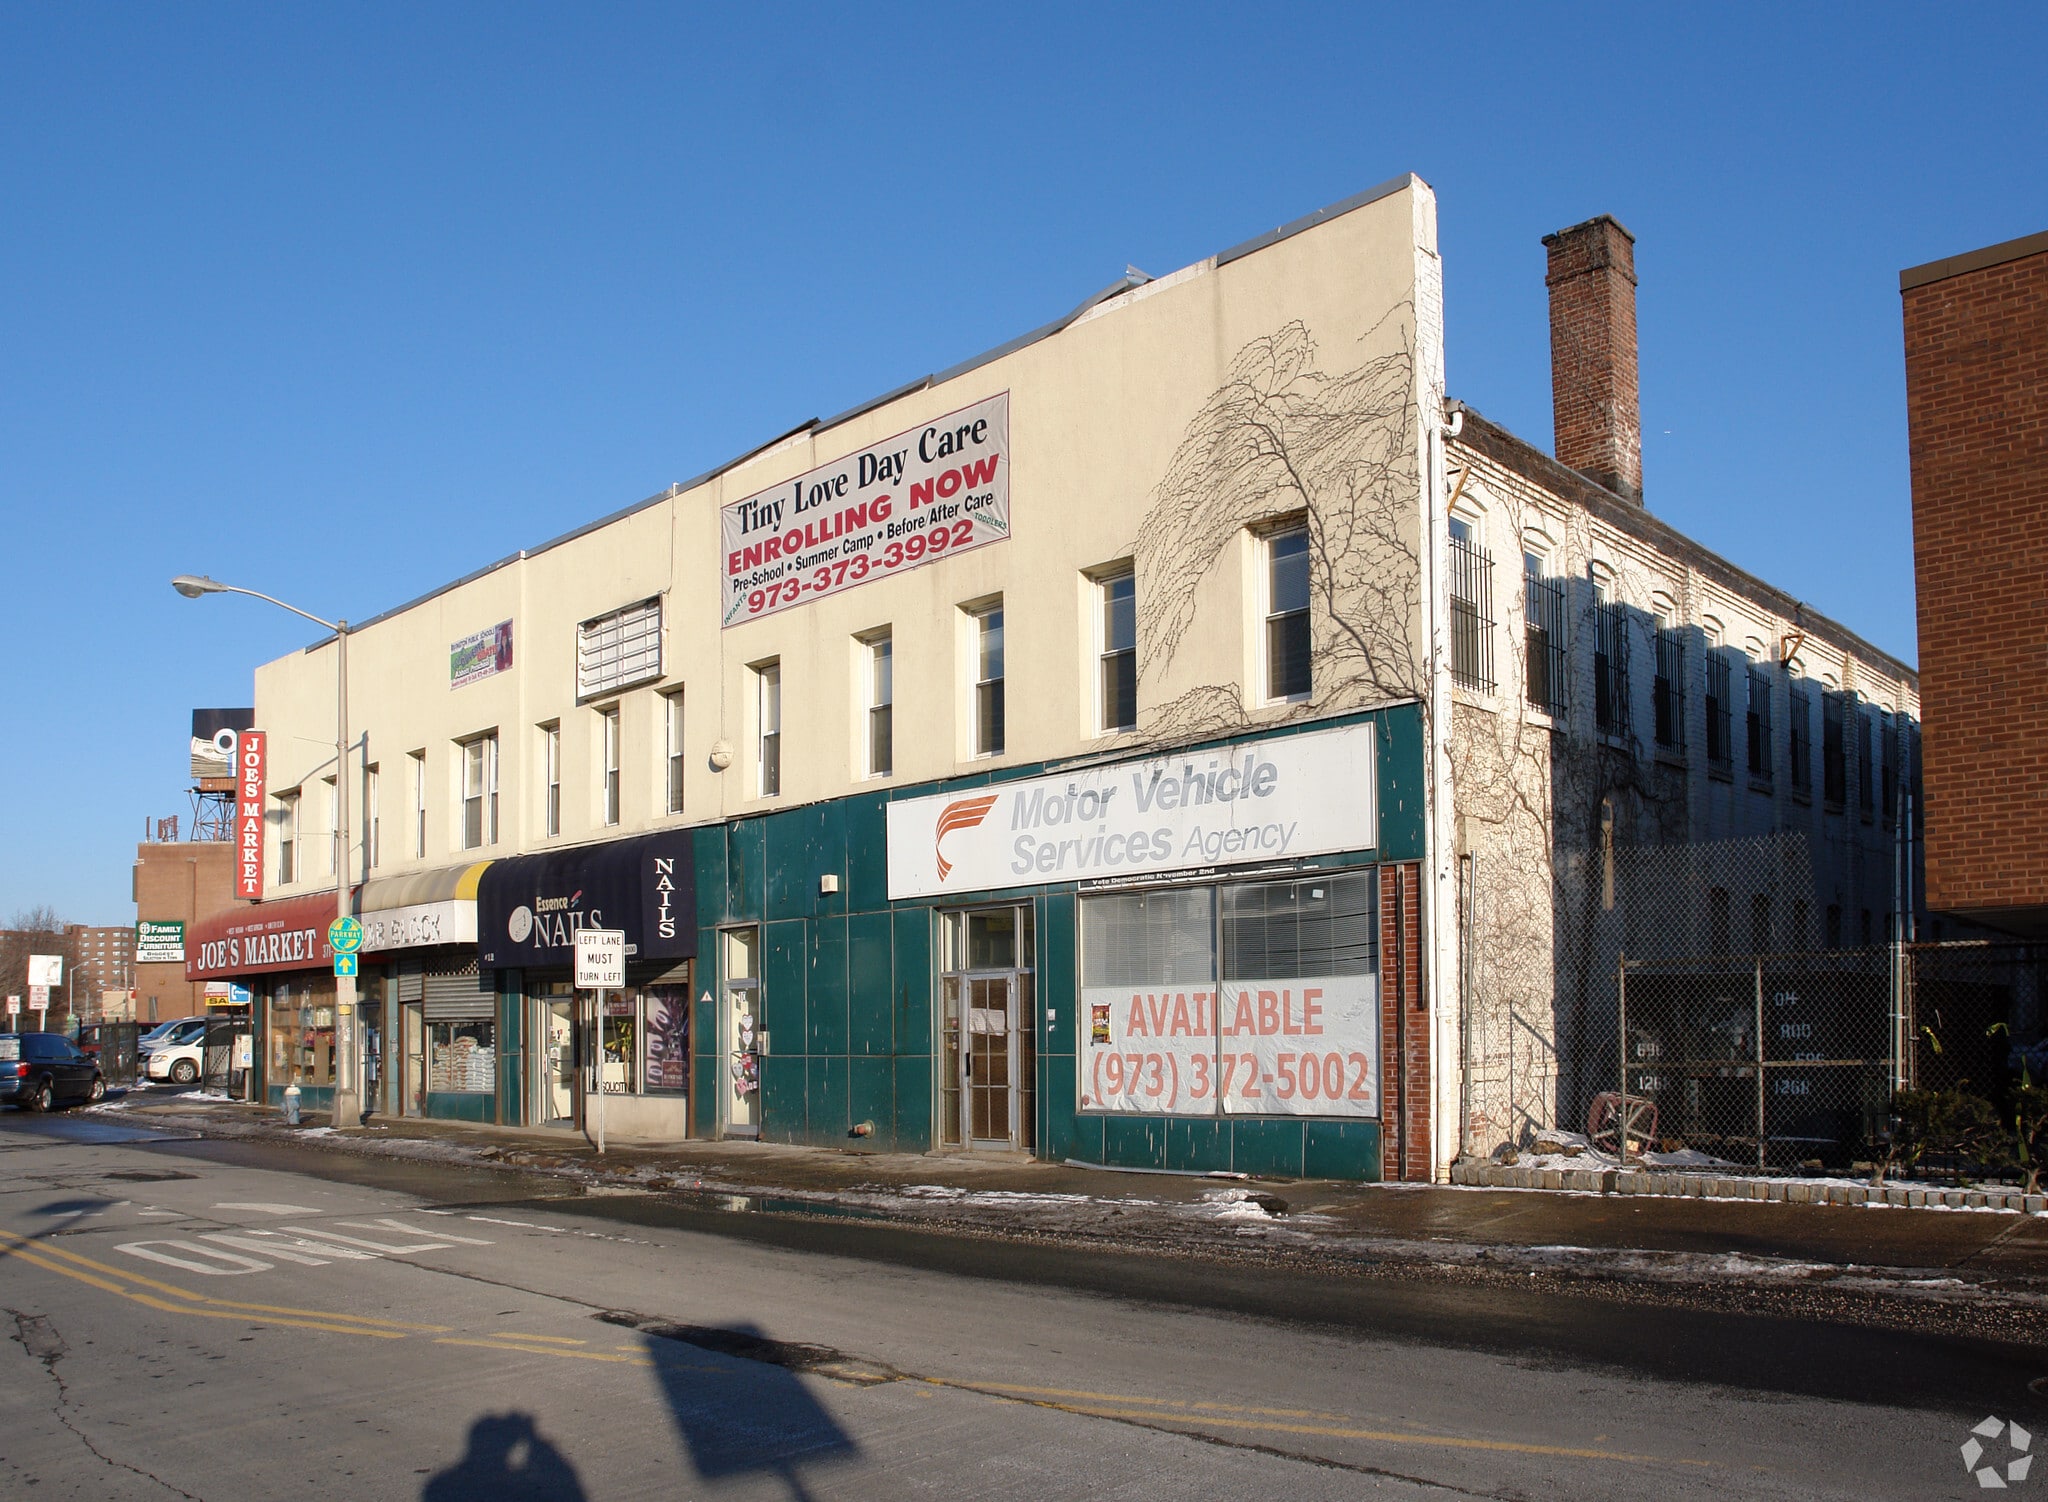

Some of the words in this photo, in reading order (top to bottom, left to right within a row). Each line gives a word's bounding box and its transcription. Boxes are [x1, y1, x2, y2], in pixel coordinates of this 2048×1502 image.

[738, 498, 785, 535] Tiny
[794, 473, 848, 514] Love
[858, 449, 908, 489] Day
[919, 419, 987, 463] Care
[729, 494, 891, 576] ENROLLING
[910, 453, 999, 510] NOW
[974, 512, 1007, 530] TODDLERS
[733, 561, 784, 593] Pre-School
[795, 546, 839, 571] Summer
[842, 534, 873, 555] Camp
[886, 502, 960, 539] Before/After
[964, 492, 994, 512] Care
[747, 520, 974, 613] 973-373-3992
[724, 592, 747, 625] INFANTS
[244, 738, 262, 798] JOE'S
[1011, 783, 1117, 830] Motor
[1132, 754, 1278, 813] Vehicle
[243, 803, 260, 892] MARKET
[1011, 825, 1173, 874] Services
[1181, 821, 1297, 862] Agency
[536, 897, 569, 912] Essence
[655, 858, 675, 938] NAILS
[138, 942, 183, 950] FURNITURE
[140, 934, 181, 942] DISCOUNT
[151, 925, 182, 933] FAMILY
[197, 937, 239, 970] JOE'S
[244, 928, 317, 966] MARKET
[330, 930, 361, 939] PARKWAY
[579, 936, 599, 945] LEFT
[602, 936, 621, 945] LANE
[579, 971, 599, 981] TURN
[603, 971, 621, 981] LEFT
[587, 953, 613, 965] MUST
[1126, 988, 1324, 1037] AVAILABLE
[1092, 1051, 1179, 1108] (973)
[1190, 1052, 1370, 1100] 372-5002
[113, 1218, 496, 1275] ONLY
